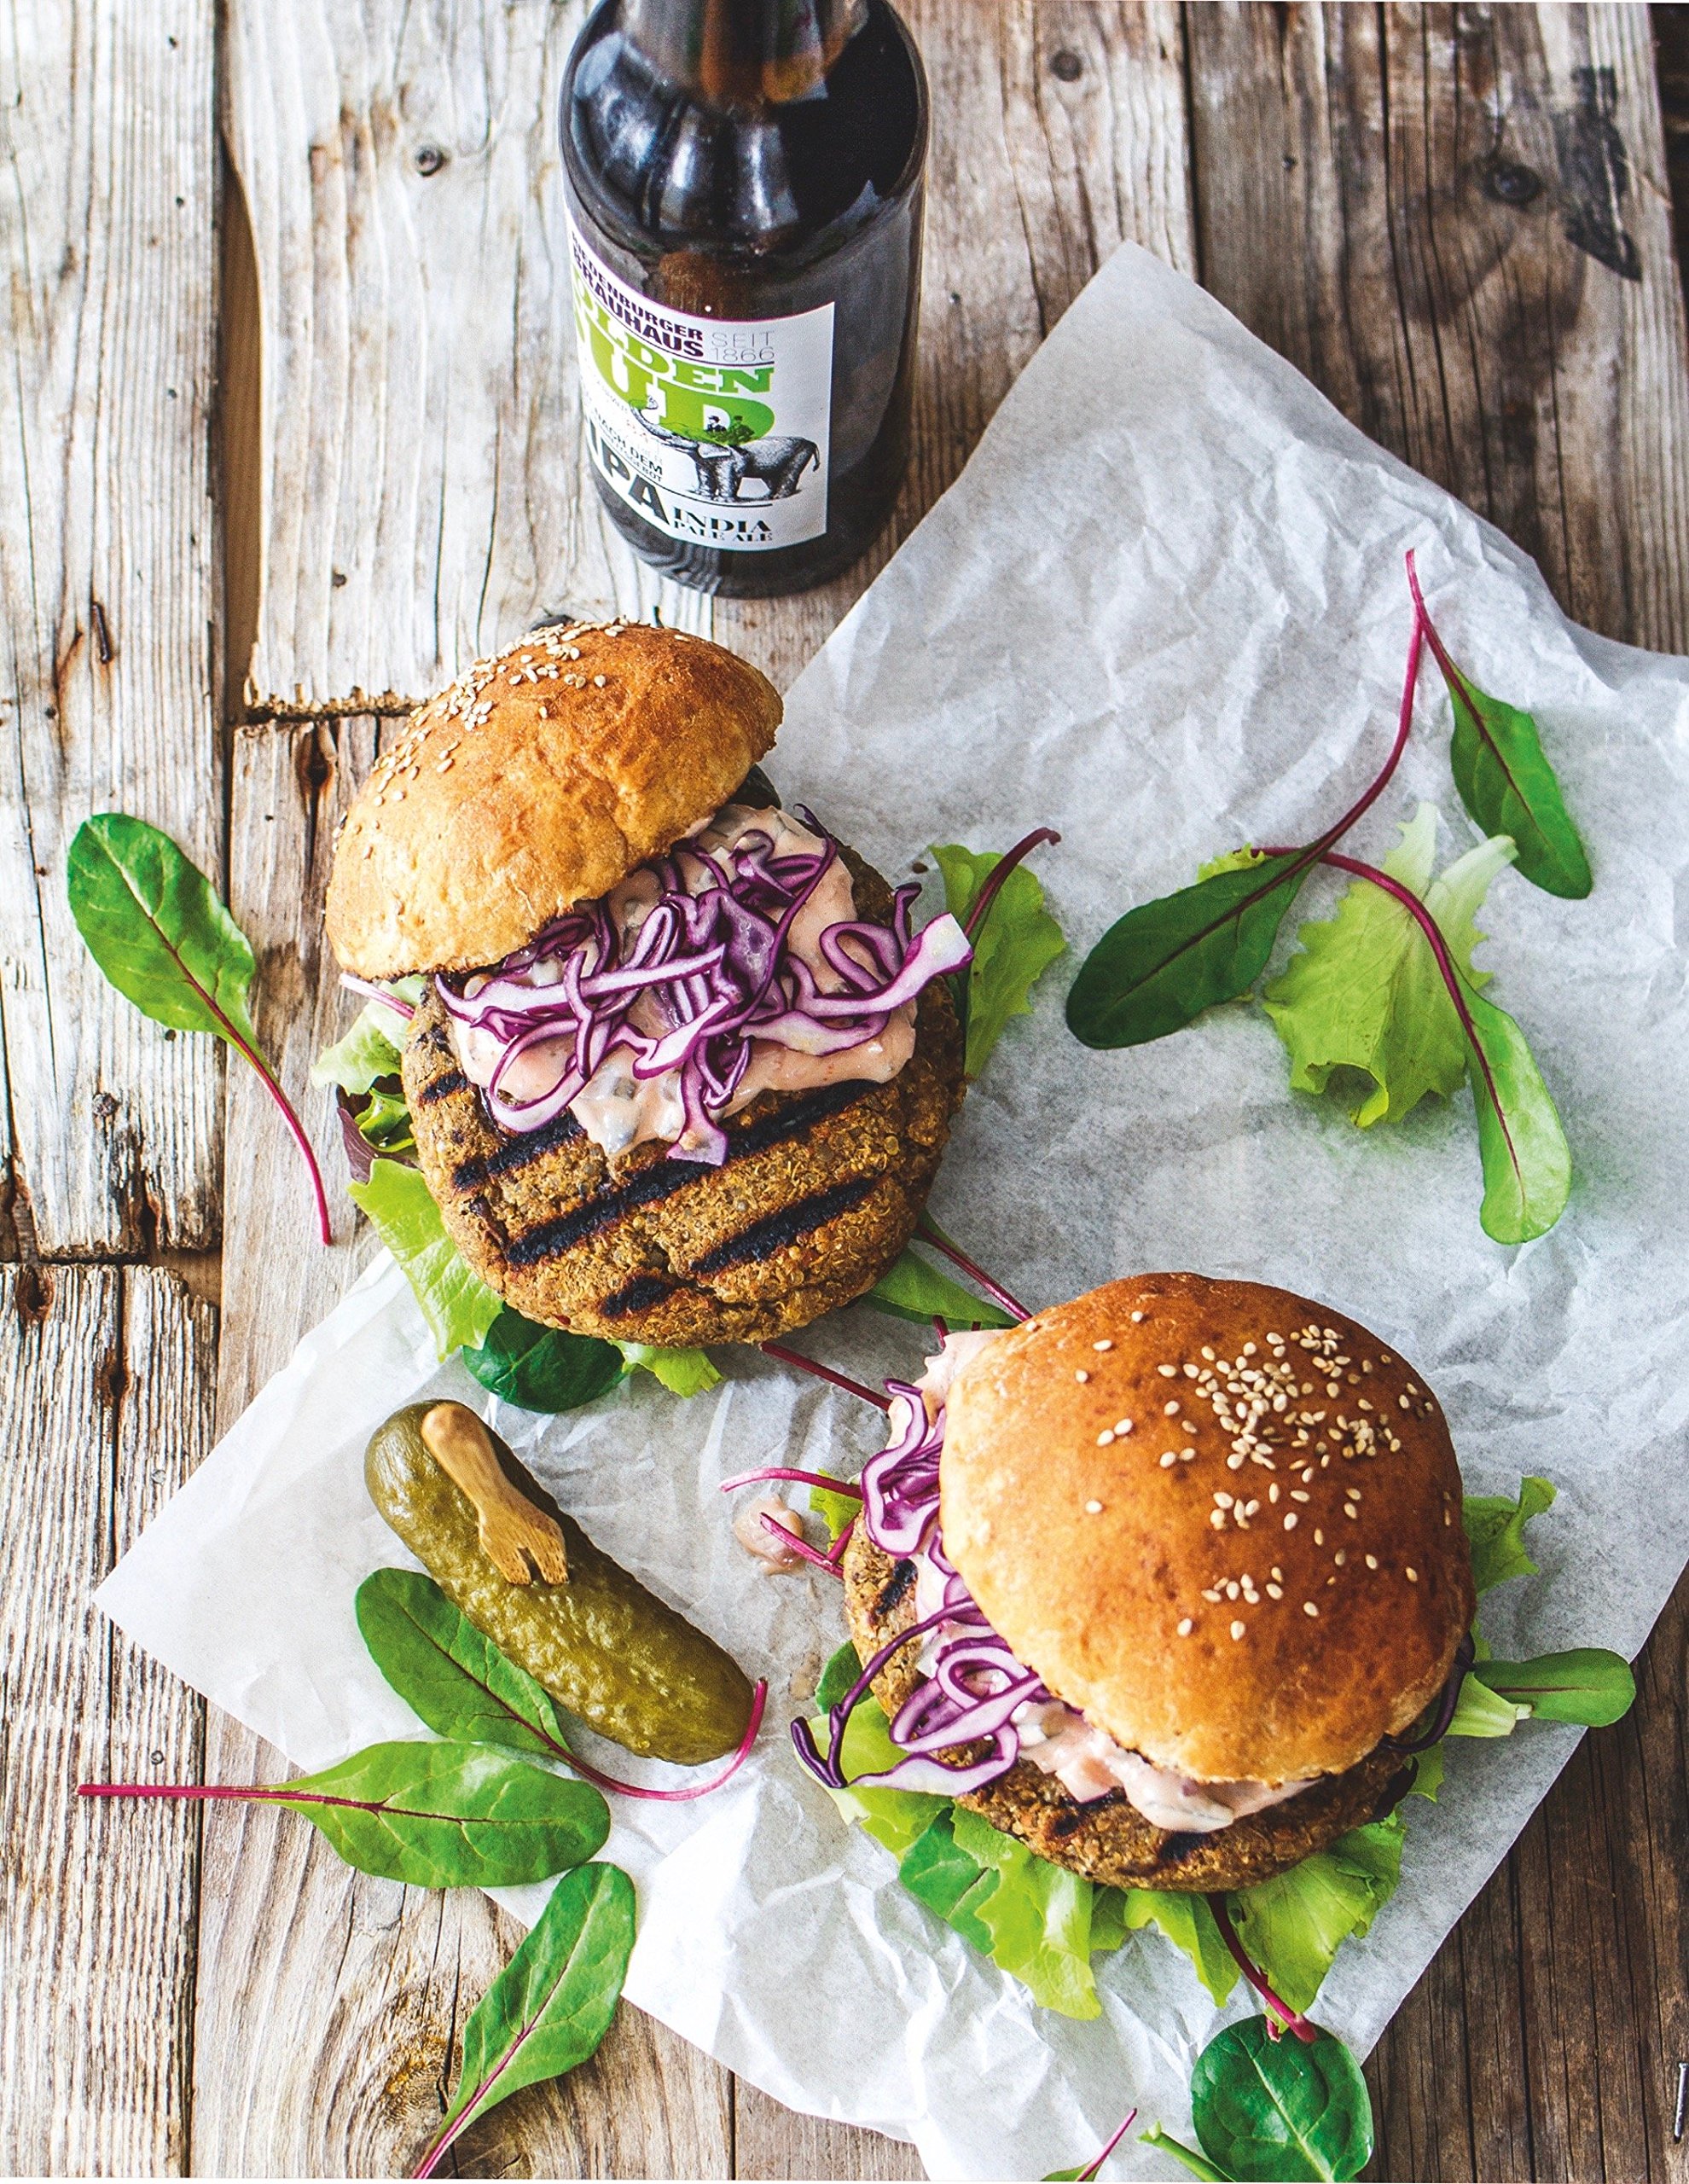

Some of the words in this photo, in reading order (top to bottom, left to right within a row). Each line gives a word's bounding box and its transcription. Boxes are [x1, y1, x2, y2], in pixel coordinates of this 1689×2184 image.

[573, 242, 705, 357] BRAUHAUS
[711, 330, 775, 349] SEIT
[712, 346, 775, 363] 1866
[588, 415, 670, 526] IPA
[630, 446, 664, 476] DEM
[673, 505, 772, 534] INDIA
[673, 520, 725, 541] PALE
[732, 531, 773, 543] ALE
